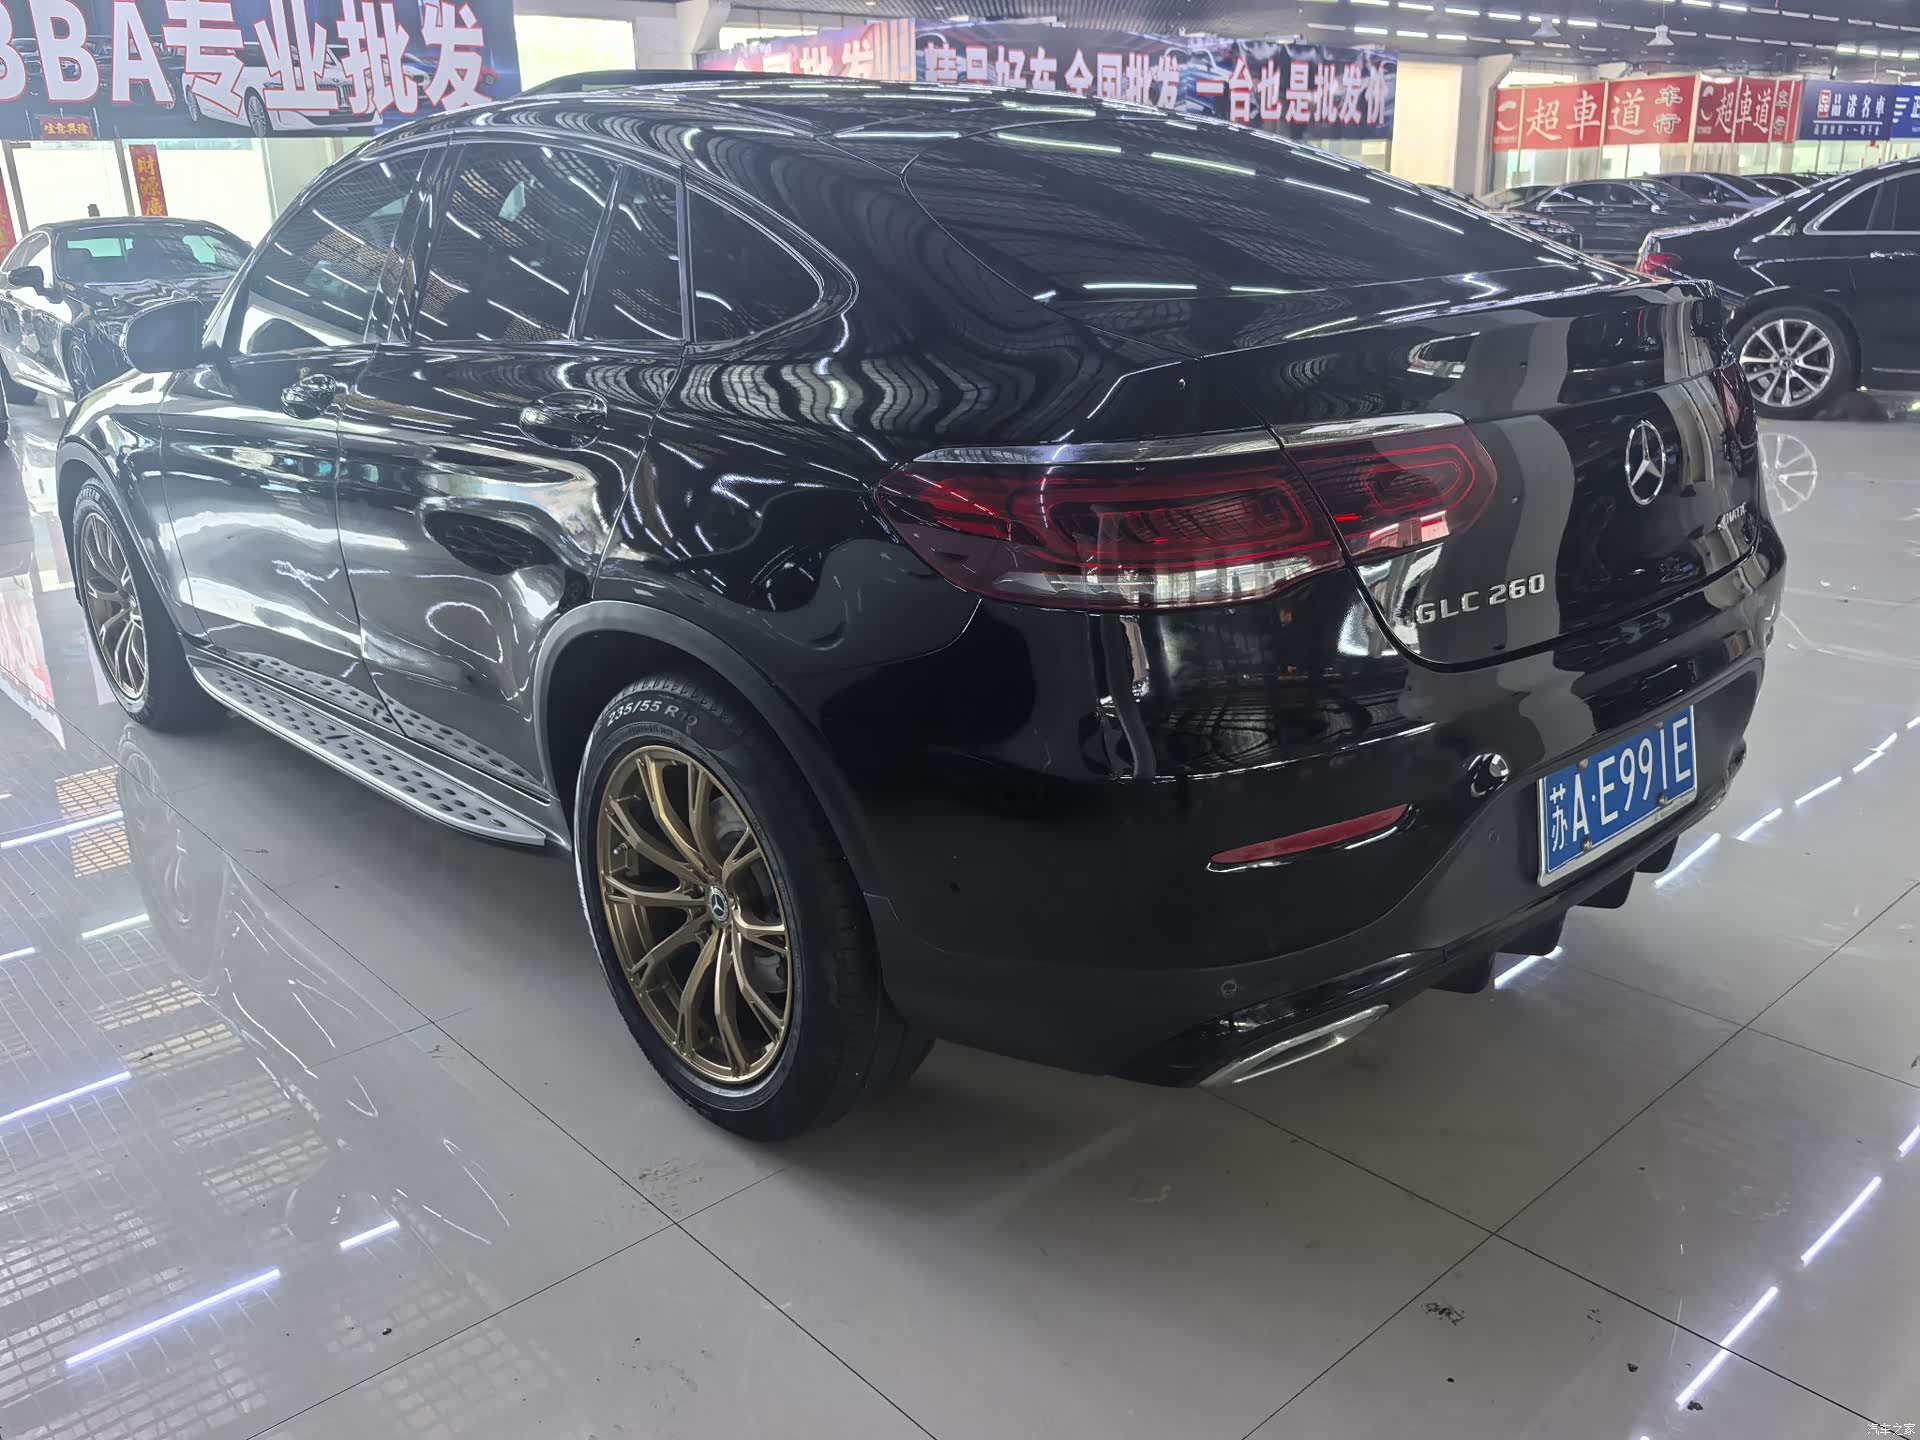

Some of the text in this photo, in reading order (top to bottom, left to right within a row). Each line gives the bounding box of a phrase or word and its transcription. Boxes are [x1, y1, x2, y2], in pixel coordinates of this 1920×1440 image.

[1415, 573, 1545, 624] GLC 260
[607, 700, 662, 727] 235/55
